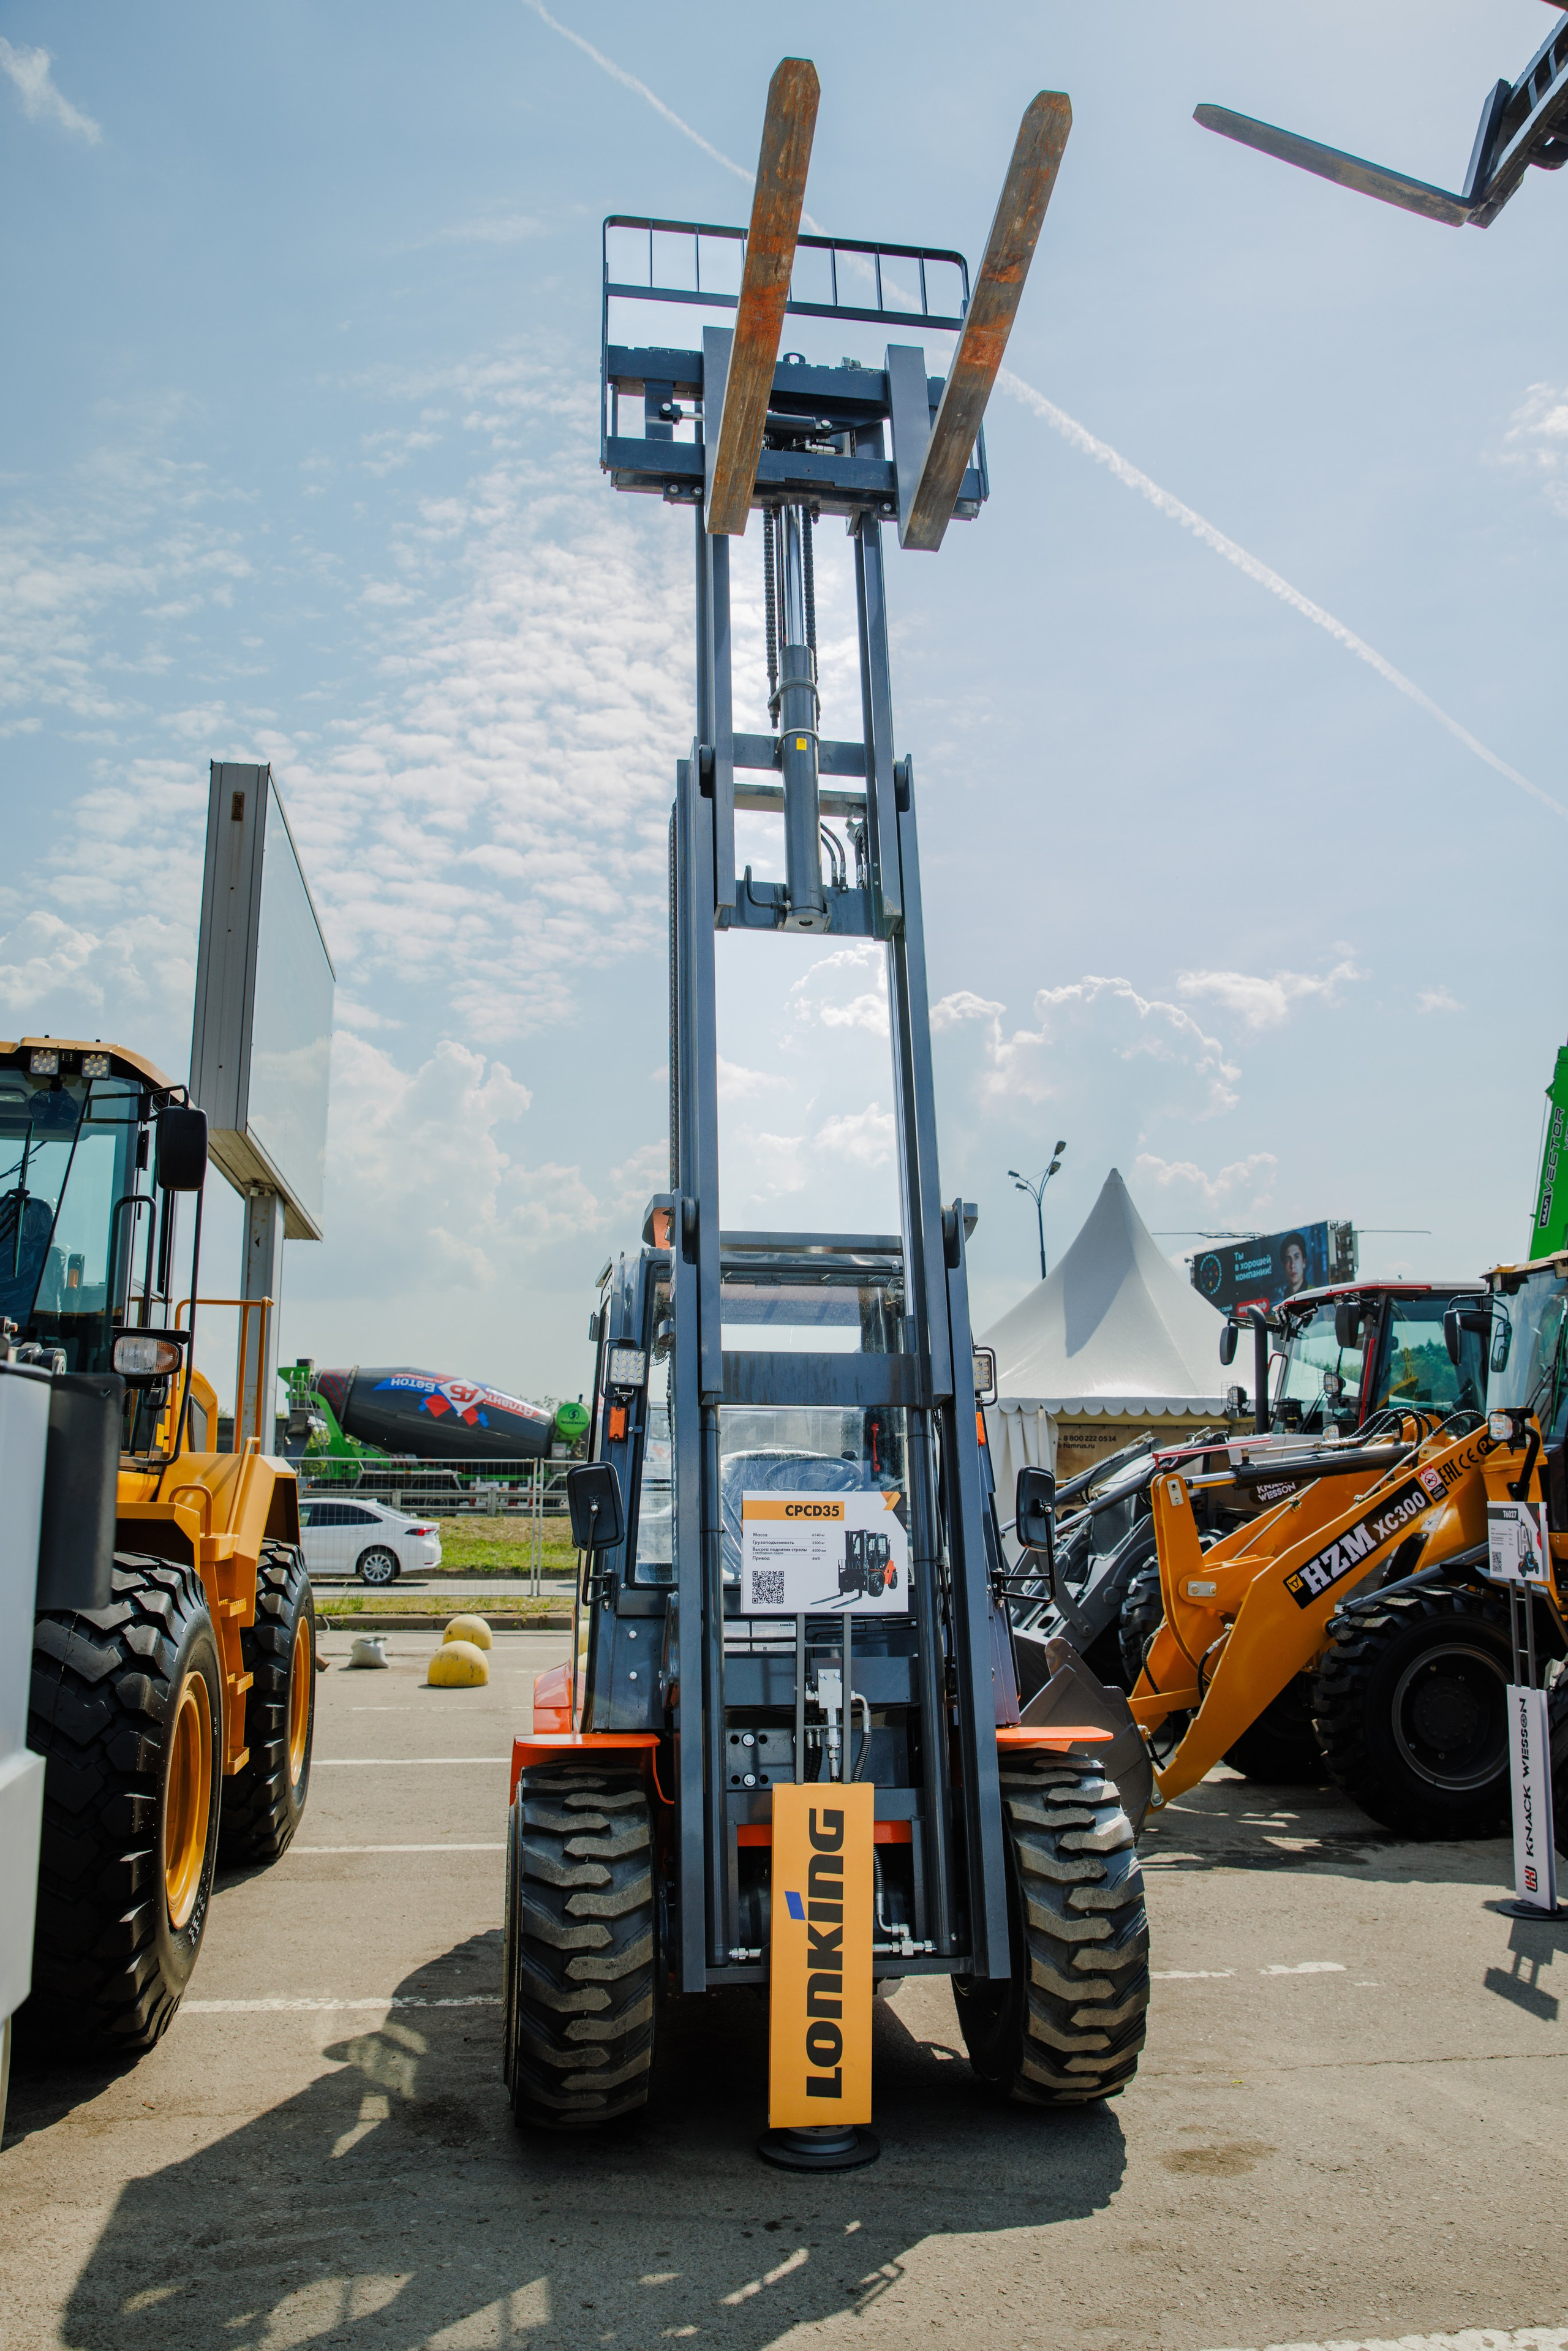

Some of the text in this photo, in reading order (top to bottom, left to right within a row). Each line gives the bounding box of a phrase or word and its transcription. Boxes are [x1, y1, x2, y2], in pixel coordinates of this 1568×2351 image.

[1541, 1107, 1564, 1224] MULTI VECTOR
[1234, 1251, 1244, 1261] Ты
[1240, 1254, 1272, 1270] хорошей
[1235, 1265, 1272, 1281] компании!
[391, 1378, 435, 1393] Бетон
[486, 1392, 535, 1417] Атлант
[1257, 1482, 1296, 1502] WESSON
[785, 1504, 839, 1517] CPCD35
[1299, 1492, 1426, 1594] HZM XC300
[1519, 1697, 1534, 1857] KNACK WESSON
